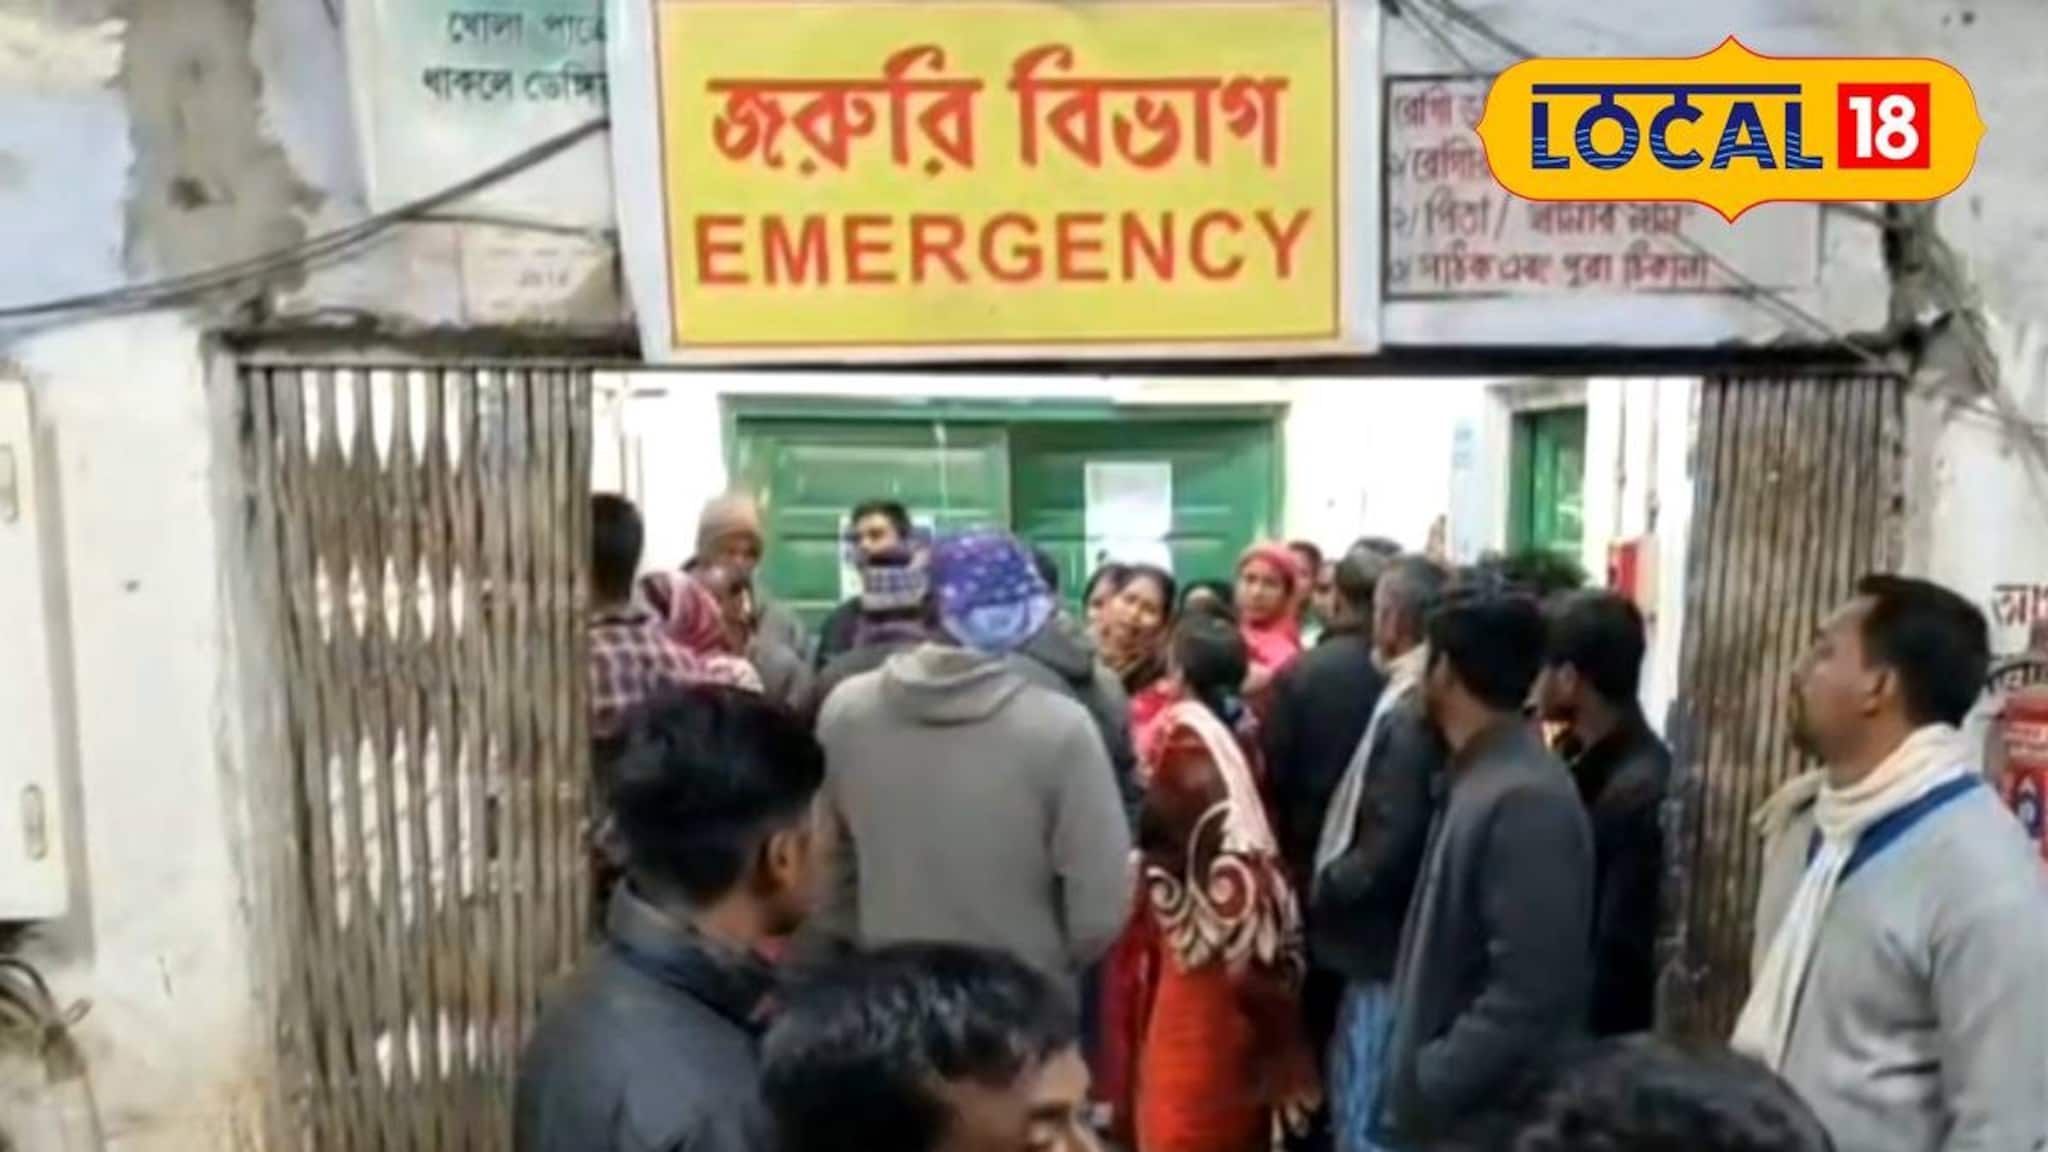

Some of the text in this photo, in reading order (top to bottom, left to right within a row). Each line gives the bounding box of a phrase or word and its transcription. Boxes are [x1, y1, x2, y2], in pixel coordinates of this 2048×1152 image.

[706, 44, 1289, 176] জরুরি বিভাগ
[694, 209, 1312, 286] EMERGENCY
